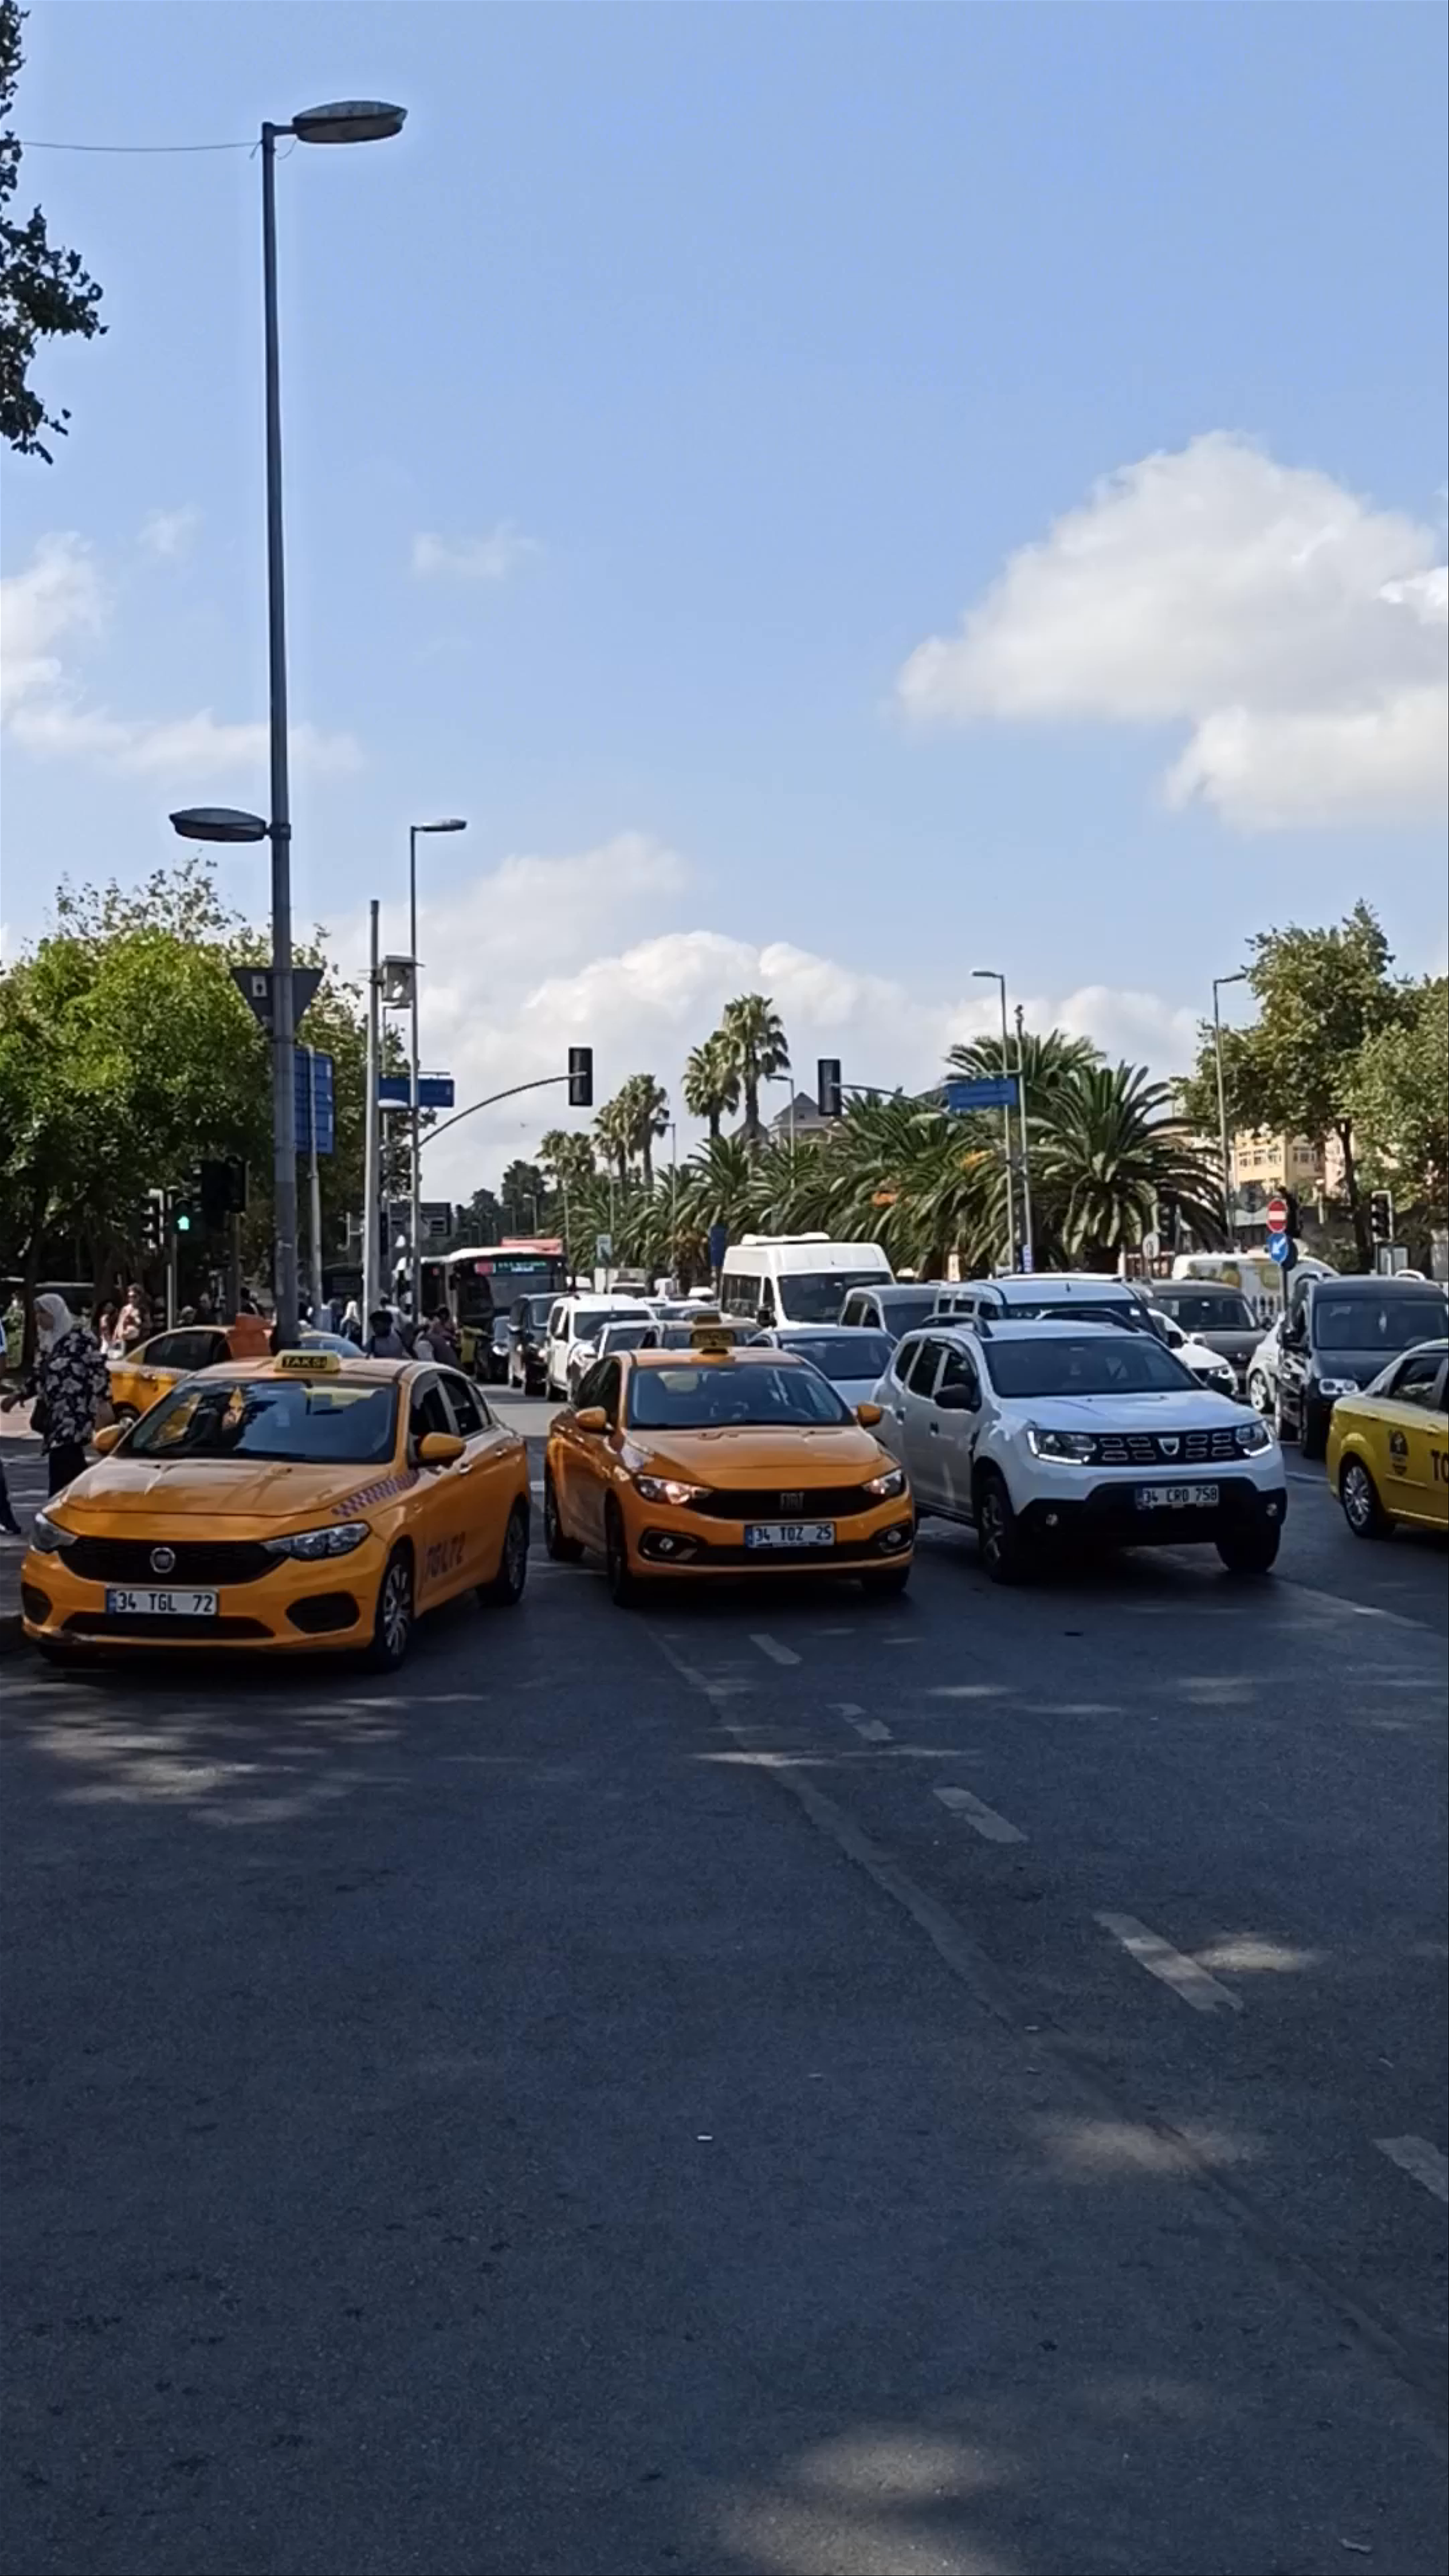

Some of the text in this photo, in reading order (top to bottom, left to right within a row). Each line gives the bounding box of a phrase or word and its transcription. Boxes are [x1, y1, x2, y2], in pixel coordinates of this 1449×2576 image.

[1143, 1490, 1159, 1503] 34
[756, 1527, 771, 1541] 34
[816, 1525, 832, 1540] 25
[117, 1592, 213, 1612] 34 TGL 72
